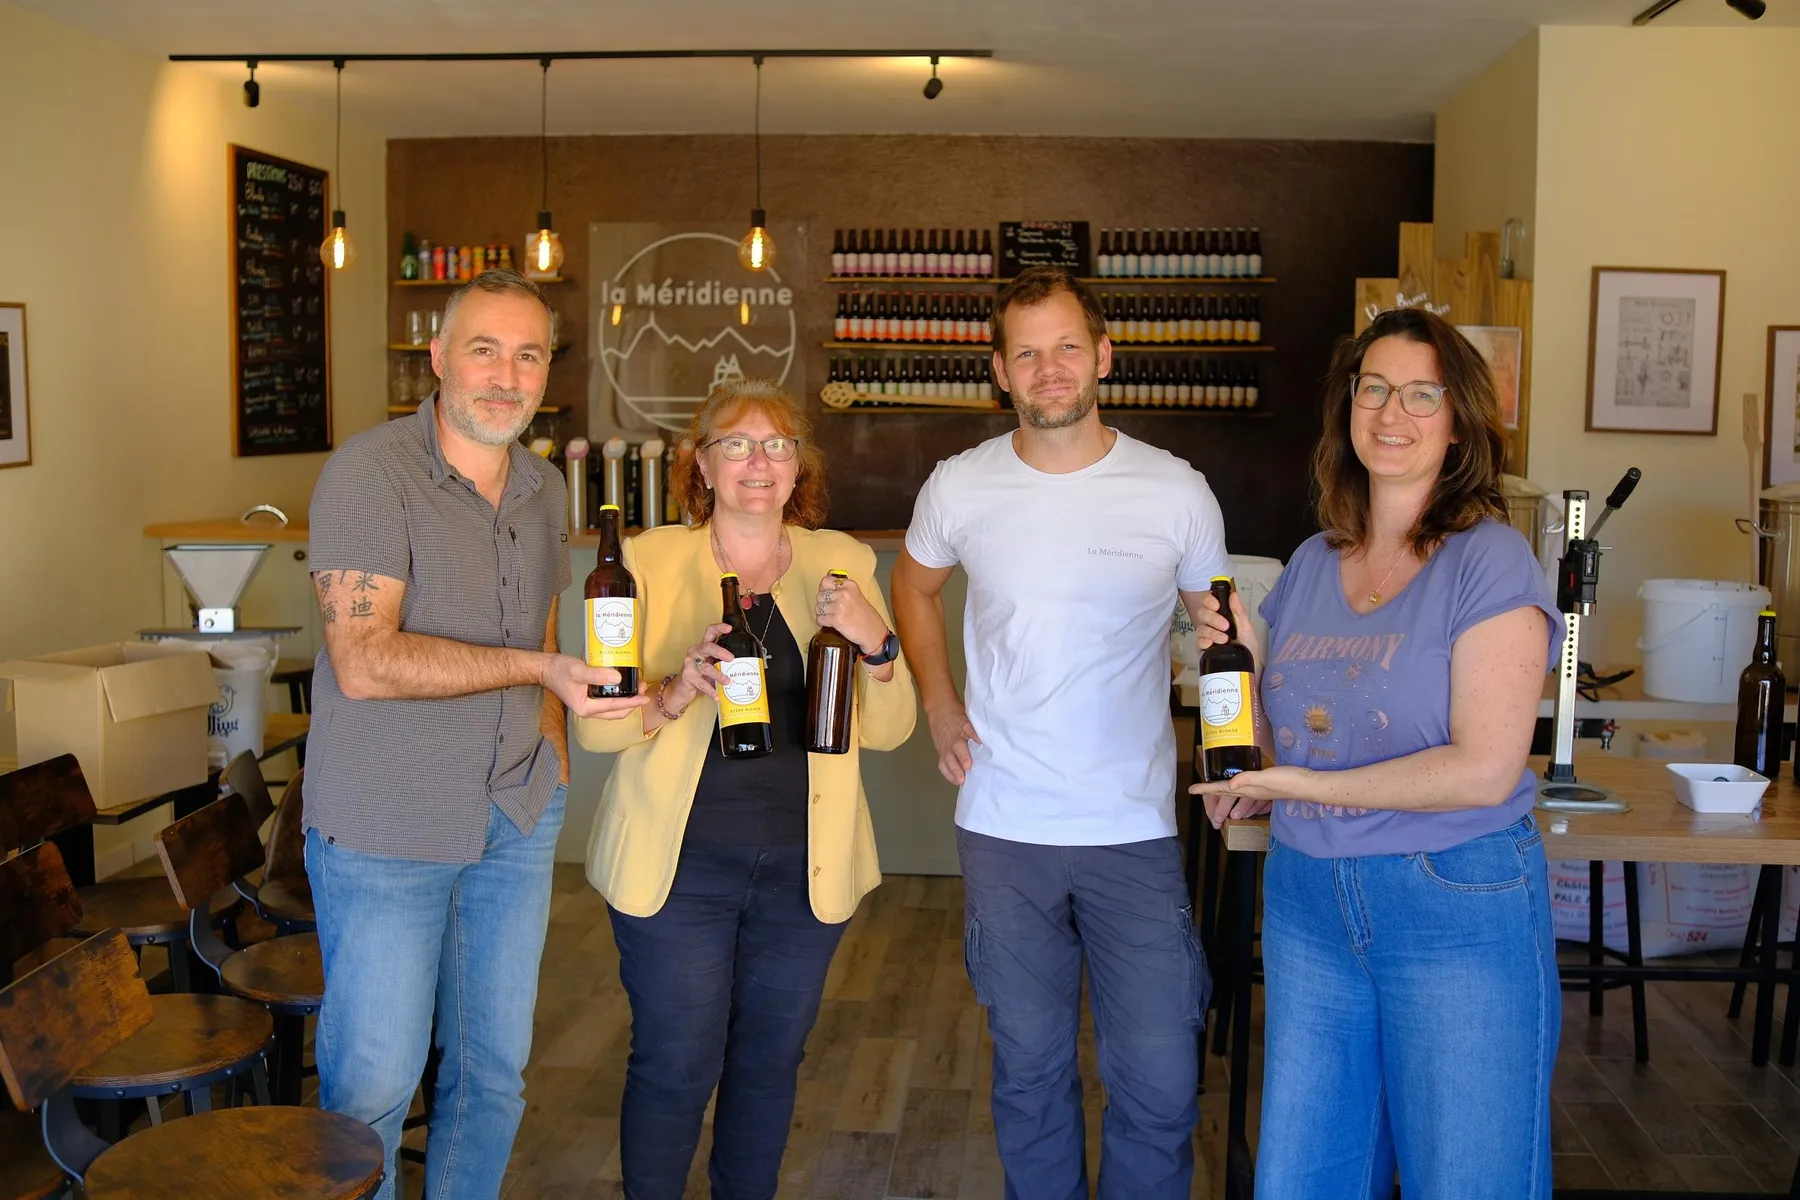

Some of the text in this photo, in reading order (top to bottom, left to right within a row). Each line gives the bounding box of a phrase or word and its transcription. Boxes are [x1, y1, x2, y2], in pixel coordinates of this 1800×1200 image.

[601, 277, 793, 305] la Méridienne
[1087, 547, 1144, 559] La Méridienne
[1274, 632, 1407, 672] HARMONY
[1205, 687, 1239, 696] Méridienne
